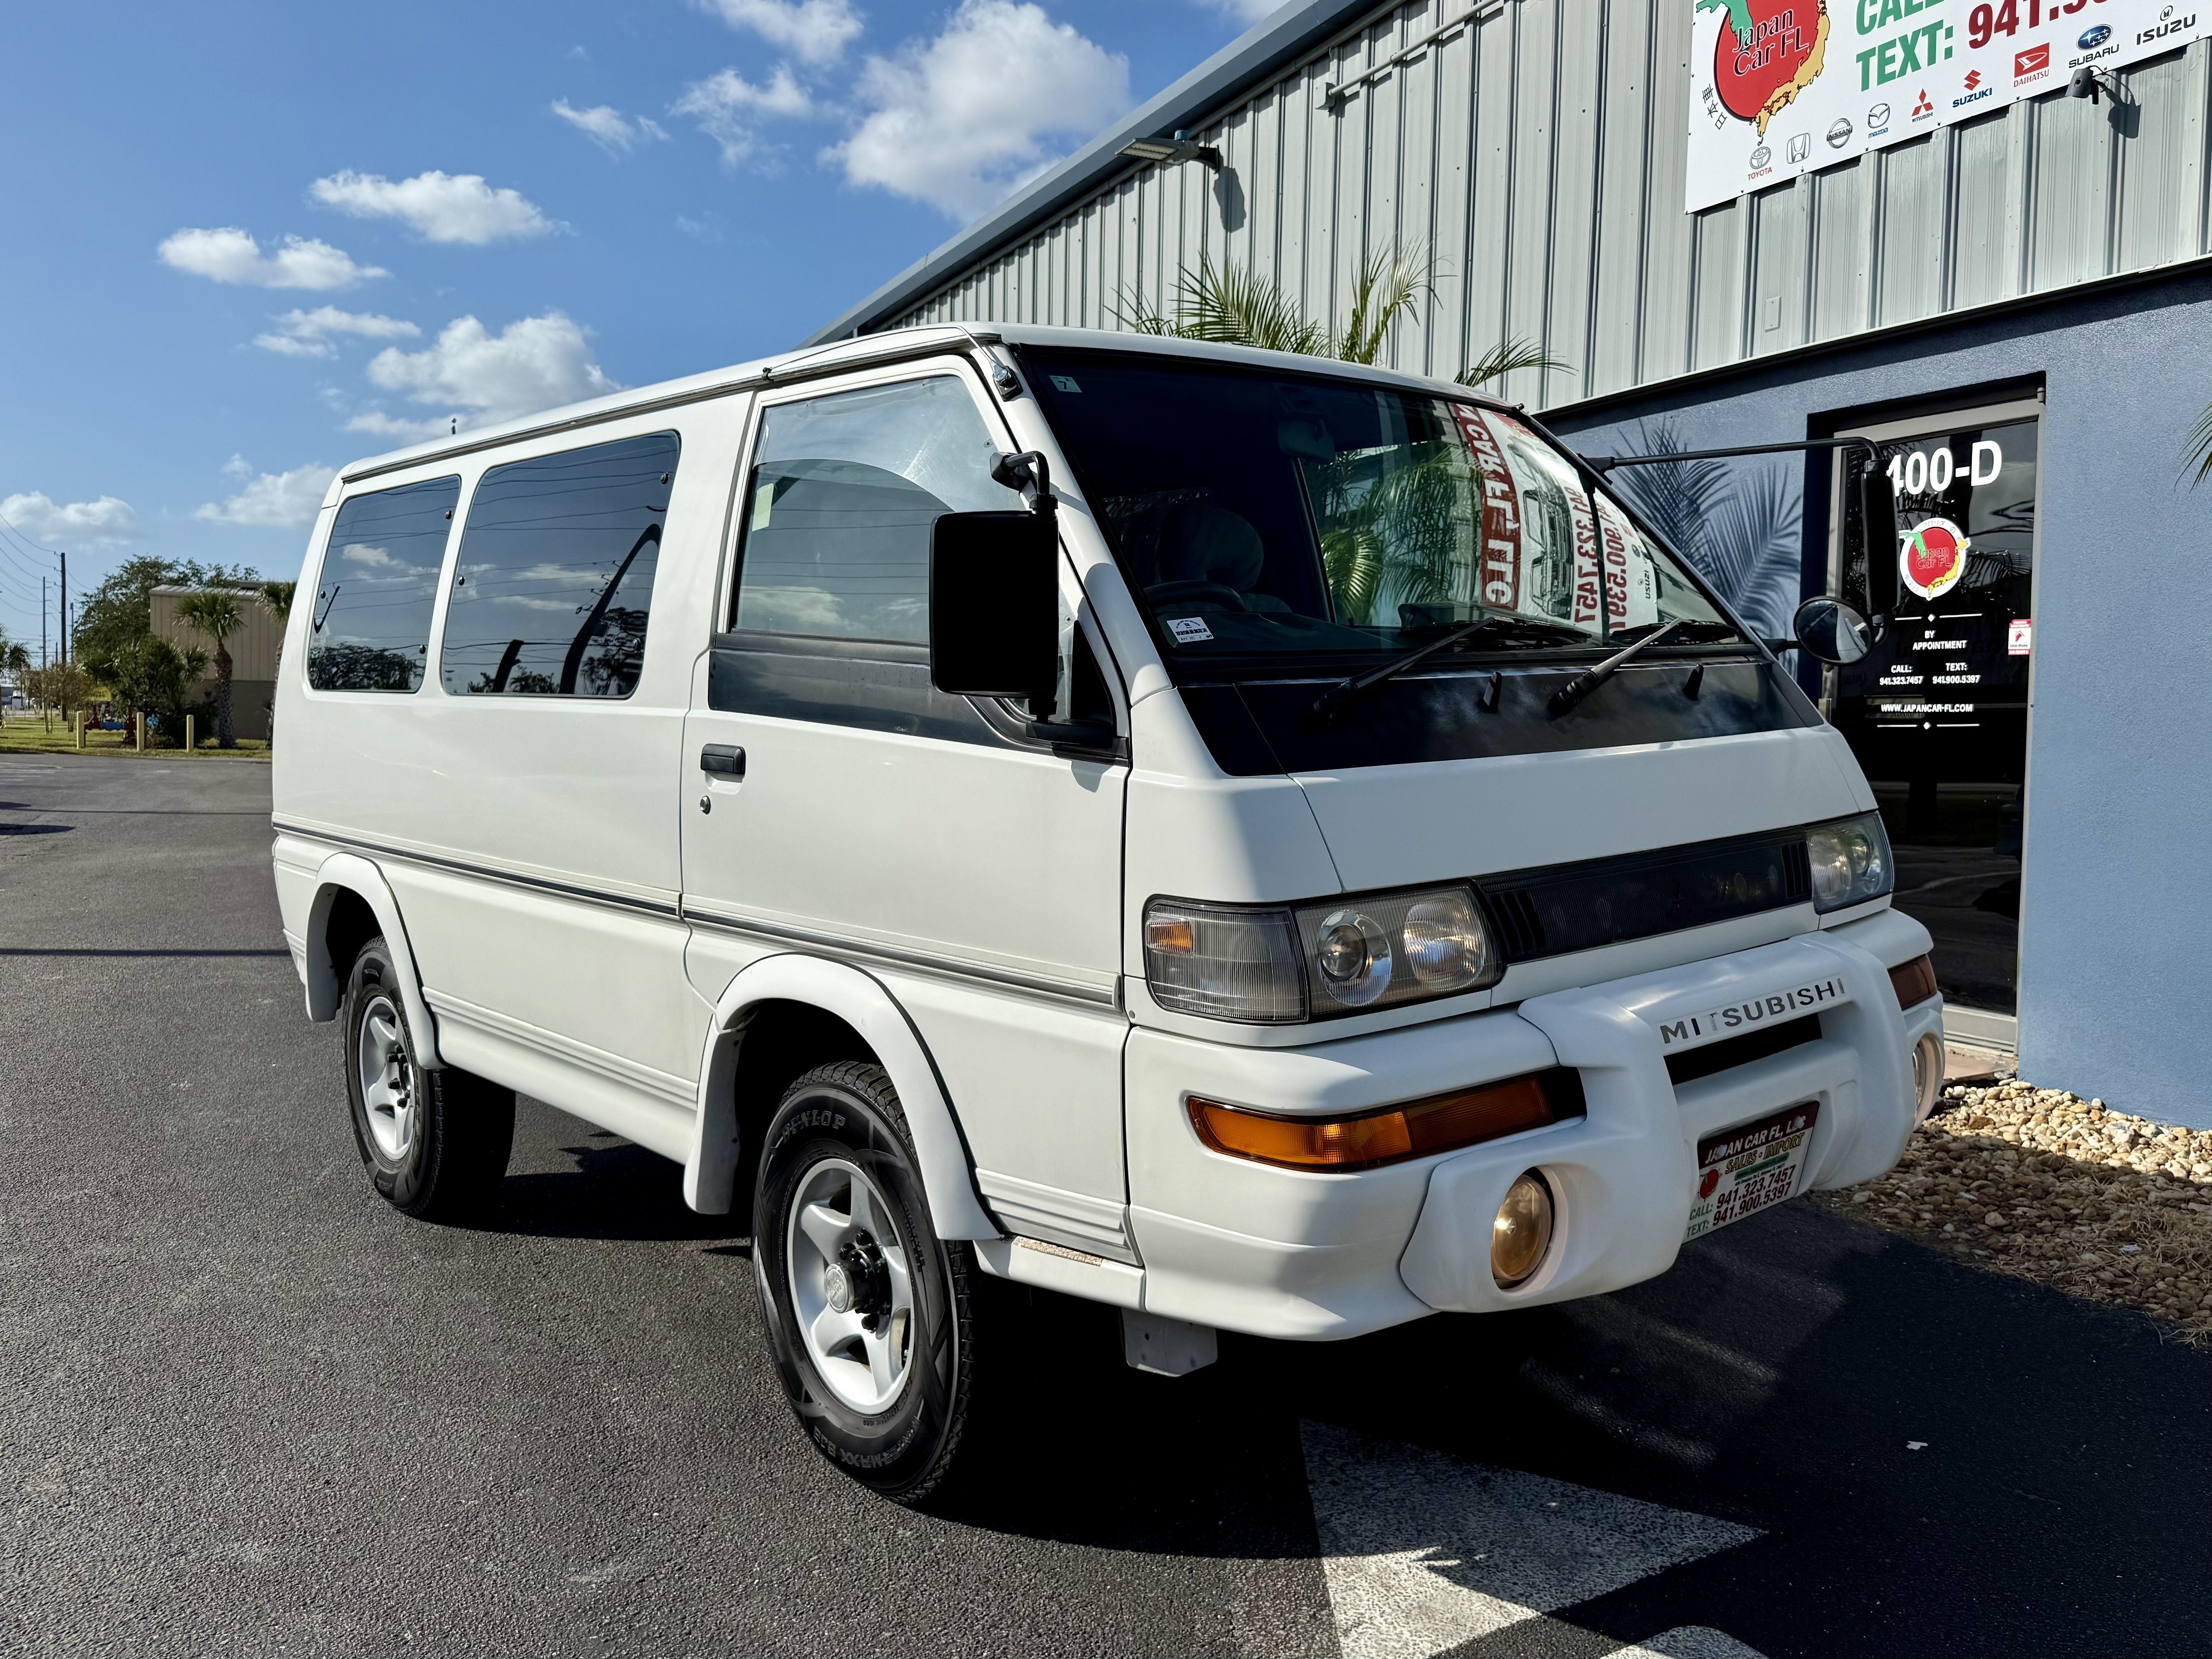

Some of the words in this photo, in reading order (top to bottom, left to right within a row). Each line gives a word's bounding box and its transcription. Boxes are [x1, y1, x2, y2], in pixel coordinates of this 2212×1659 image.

[1732, 9, 1794, 53] Japan
[2136, 14, 2196, 45] ISUZU
[1733, 42, 1776, 76] Car
[1780, 26, 1810, 58] FL
[1856, 19, 1953, 92] TEXT:
[2068, 44, 2119, 69] SUBARU
[2014, 69, 2049, 88] DAIHATSU
[1953, 88, 1992, 108] SUZUKI
[1912, 112, 1933, 123] MITSUBISHI
[1829, 128, 1850, 139] NISSAN
[1868, 128, 1888, 139] mazda
[1748, 167, 1772, 181] TOYOTA
[1887, 440, 2002, 497] 400-D
[1917, 548, 1948, 560] Japan
[1917, 560, 1935, 568] Car
[1939, 557, 1952, 567] FL
[1913, 640, 1968, 650] APPOINTMENT
[1891, 665, 1913, 673] CALL:
[1945, 662, 1968, 671] TEXT:
[1879, 676, 1924, 685] 941.323.7457
[1933, 675, 1981, 684] 941.900.5397
[1660, 978, 1845, 1044] MITSUBISHI
[781, 1110, 846, 1144] DUNLOP
[1744, 1129, 1768, 1149] CAR
[1768, 1125, 1783, 1140] FL,
[1725, 1150, 1757, 1175] SALES
[1763, 1132, 1805, 1160] IMPORT
[1690, 1203, 1713, 1221] CALL:
[1716, 1164, 1796, 1210] 941.323.7457
[1686, 1220, 1709, 1238] TEXT:
[1712, 1181, 1792, 1226] 941.900.5397
